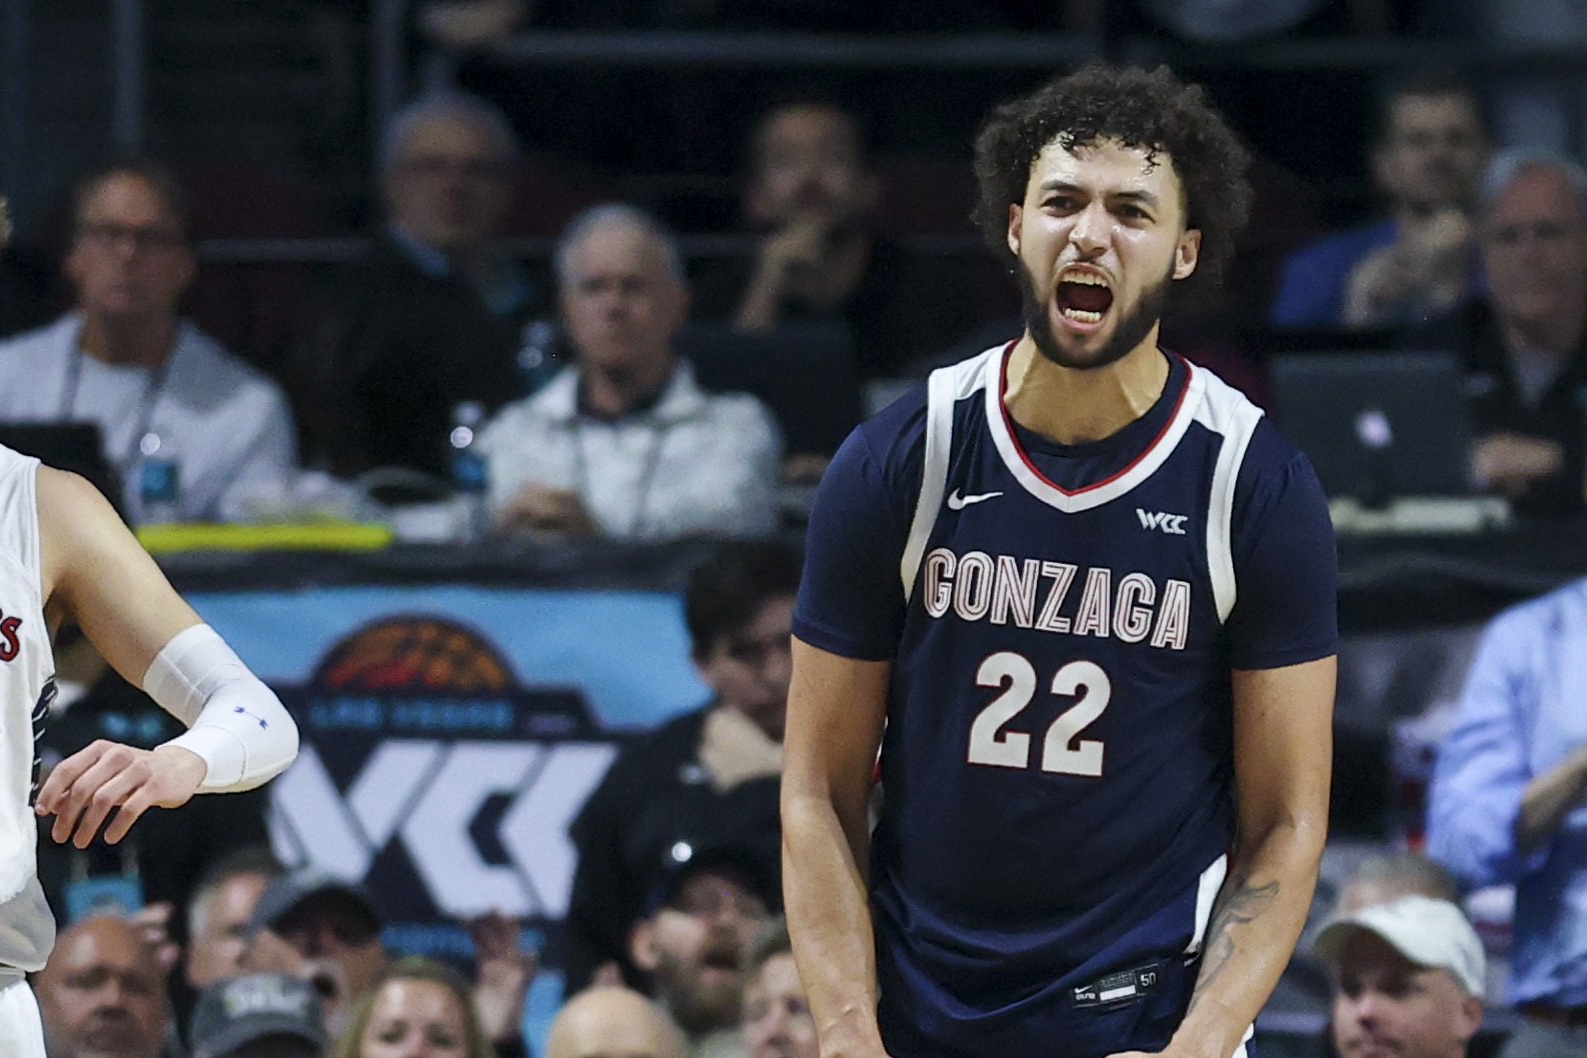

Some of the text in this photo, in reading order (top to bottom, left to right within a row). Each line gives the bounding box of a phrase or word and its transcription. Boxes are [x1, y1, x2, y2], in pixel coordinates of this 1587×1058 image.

[1136, 508, 1189, 535] WCC
[923, 546, 1191, 650] GONZAGA
[967, 650, 1112, 778] 22
[1140, 972, 1157, 987] 50
